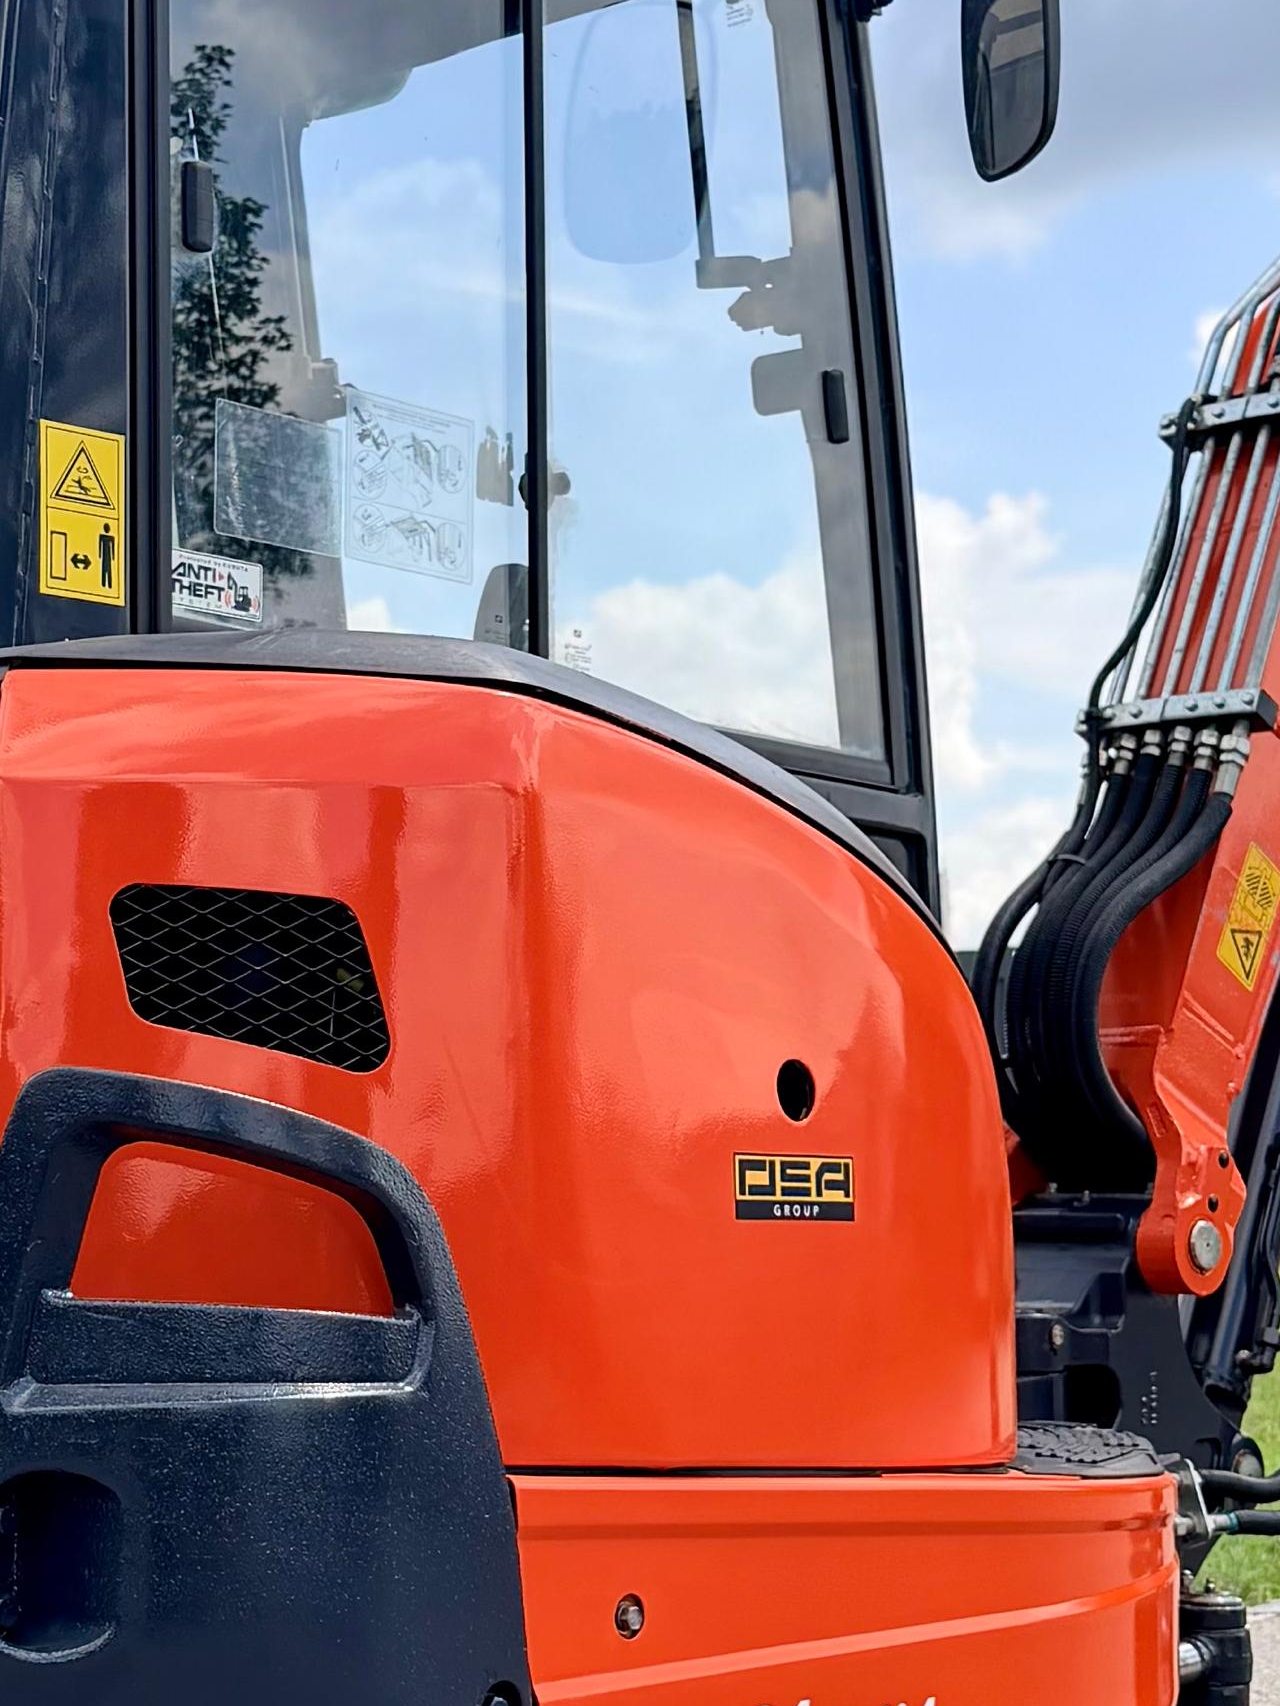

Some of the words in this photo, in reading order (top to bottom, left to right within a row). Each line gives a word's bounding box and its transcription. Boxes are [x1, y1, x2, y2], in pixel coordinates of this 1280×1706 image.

[171, 561, 217, 584] ANTI
[171, 577, 226, 603] THEFT
[773, 1203, 821, 1217] GROUP
